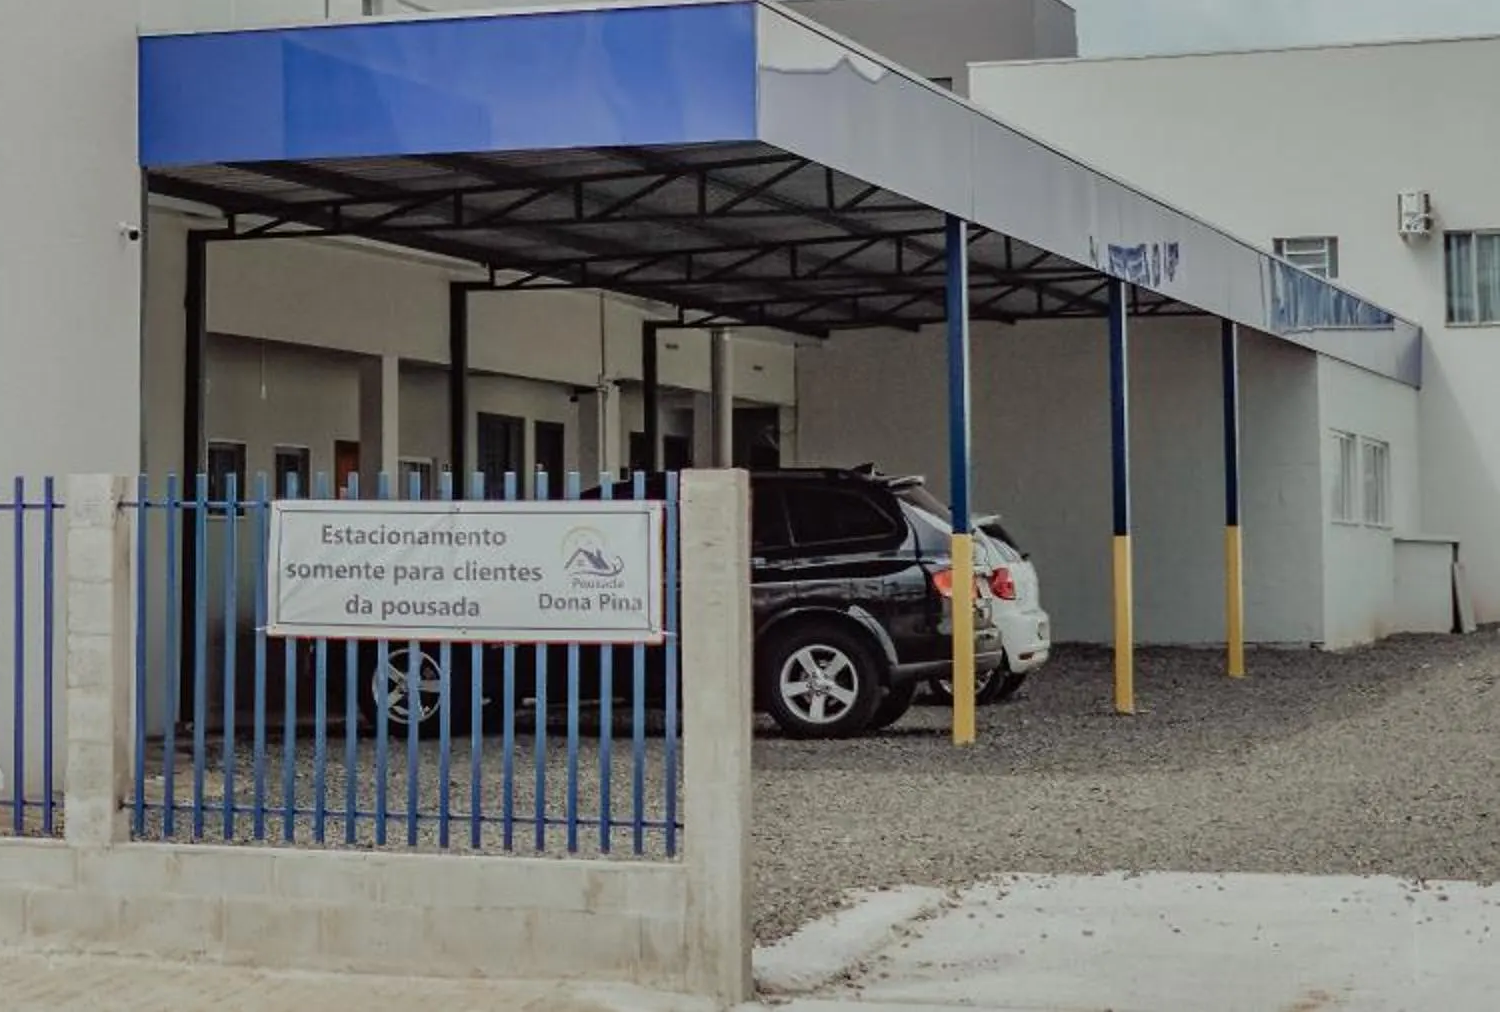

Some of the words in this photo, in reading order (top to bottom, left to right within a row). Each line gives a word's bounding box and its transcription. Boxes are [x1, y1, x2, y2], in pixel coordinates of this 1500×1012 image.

[321, 524, 507, 546] Estacionamento
[286, 562, 385, 580] somente
[394, 565, 445, 586] para
[453, 561, 543, 582] clientes
[345, 594, 373, 616] da
[381, 596, 481, 620] pousada
[539, 592, 591, 611] Dona
[599, 592, 643, 612] Pina
